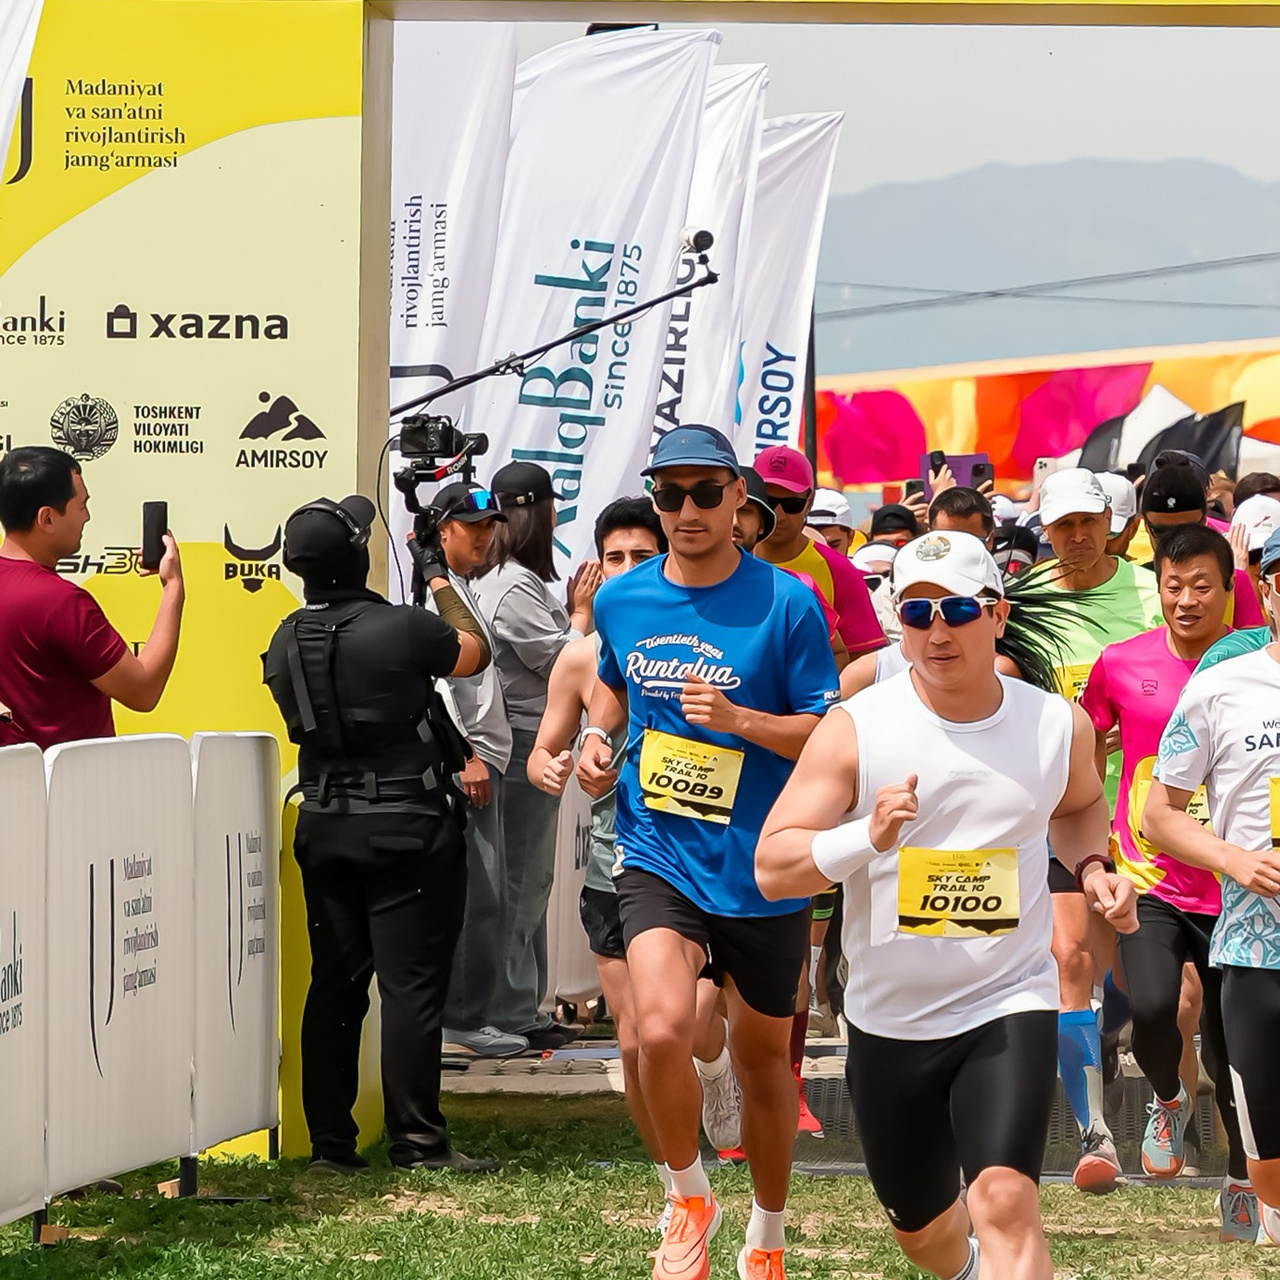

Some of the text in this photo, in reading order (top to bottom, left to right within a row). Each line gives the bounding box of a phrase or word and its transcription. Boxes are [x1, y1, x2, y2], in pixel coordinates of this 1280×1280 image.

[65, 77, 165, 101] Madaniyat
[65, 105, 87, 121] va
[65, 127, 187, 149] rivojlantirish
[400, 194, 423, 329] rivojlantirish
[149, 311, 290, 340] xazna
[603, 244, 643, 410] Since 1875
[32, 334, 66, 346] 1875
[133, 404, 202, 420] TOSHKENT
[133, 422, 190, 437] VILOYATI
[133, 439, 204, 454] HOKIMLIGI
[235, 448, 329, 469] AMIRSOY
[224, 563, 281, 580] BUKA
[661, 756, 715, 773] SKY CAMP
[664, 765, 708, 781] TRAIL 10
[648, 772, 724, 800] 10089
[926, 875, 991, 883] SKY CAMP
[932, 883, 985, 892] TRAIL 10
[919, 895, 1002, 913] 10100
